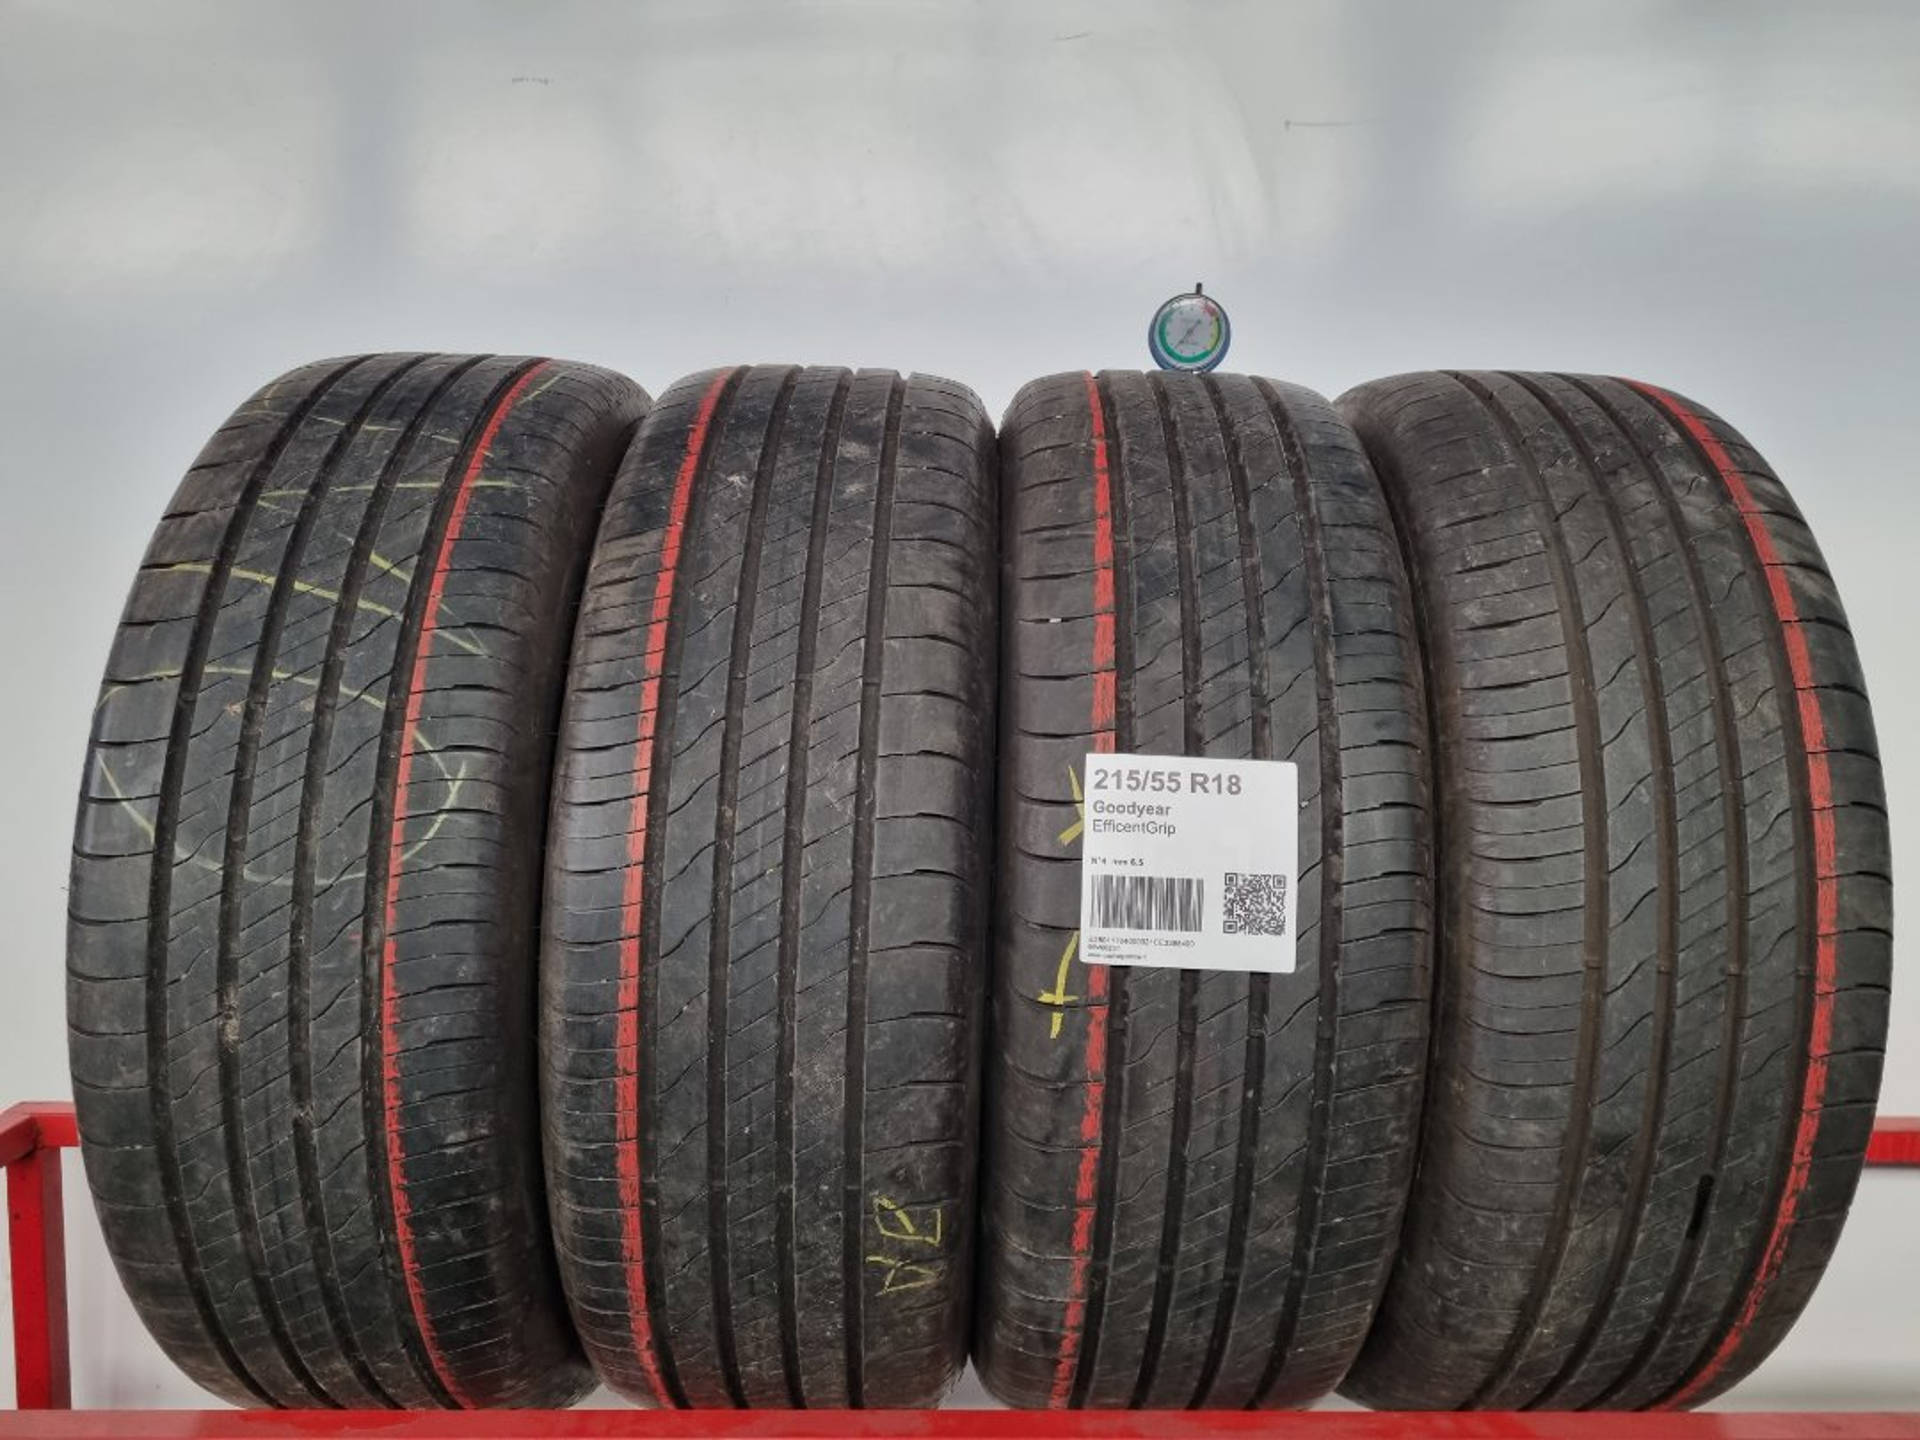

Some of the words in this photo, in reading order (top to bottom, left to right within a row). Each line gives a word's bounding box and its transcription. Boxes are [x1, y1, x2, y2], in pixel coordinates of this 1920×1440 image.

[1093, 768, 1181, 793] 215/55
[1190, 772, 1242, 796] R18
[1092, 800, 1171, 818] Goodyear
[1092, 820, 1176, 837] EfficentGrip
[1130, 858, 1145, 867] 6.5
